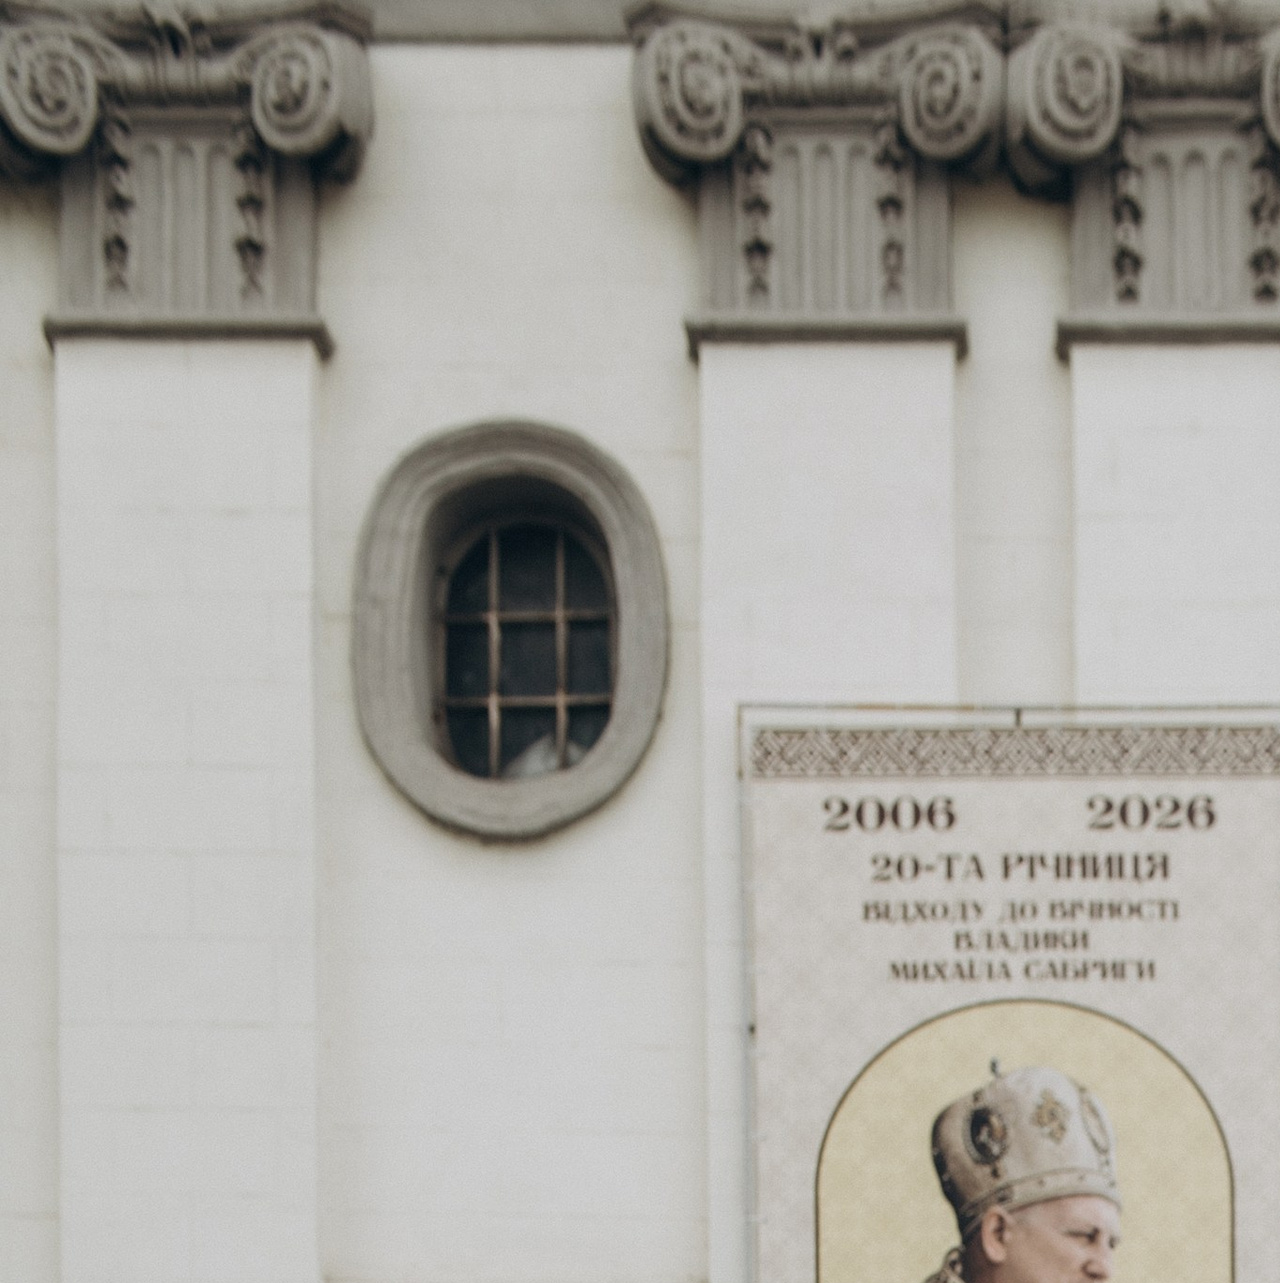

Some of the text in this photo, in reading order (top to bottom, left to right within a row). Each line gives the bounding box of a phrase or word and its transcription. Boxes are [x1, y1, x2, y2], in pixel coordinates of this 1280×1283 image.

[821, 794, 1217, 833] 2006 2026
[870, 851, 1170, 885] 20-ТА РІЧНИЦЯ
[862, 898, 1180, 925] ВІДХОДУ ДО ВІЧНОСТІ
[953, 930, 1089, 953] ВЛАДИКИ
